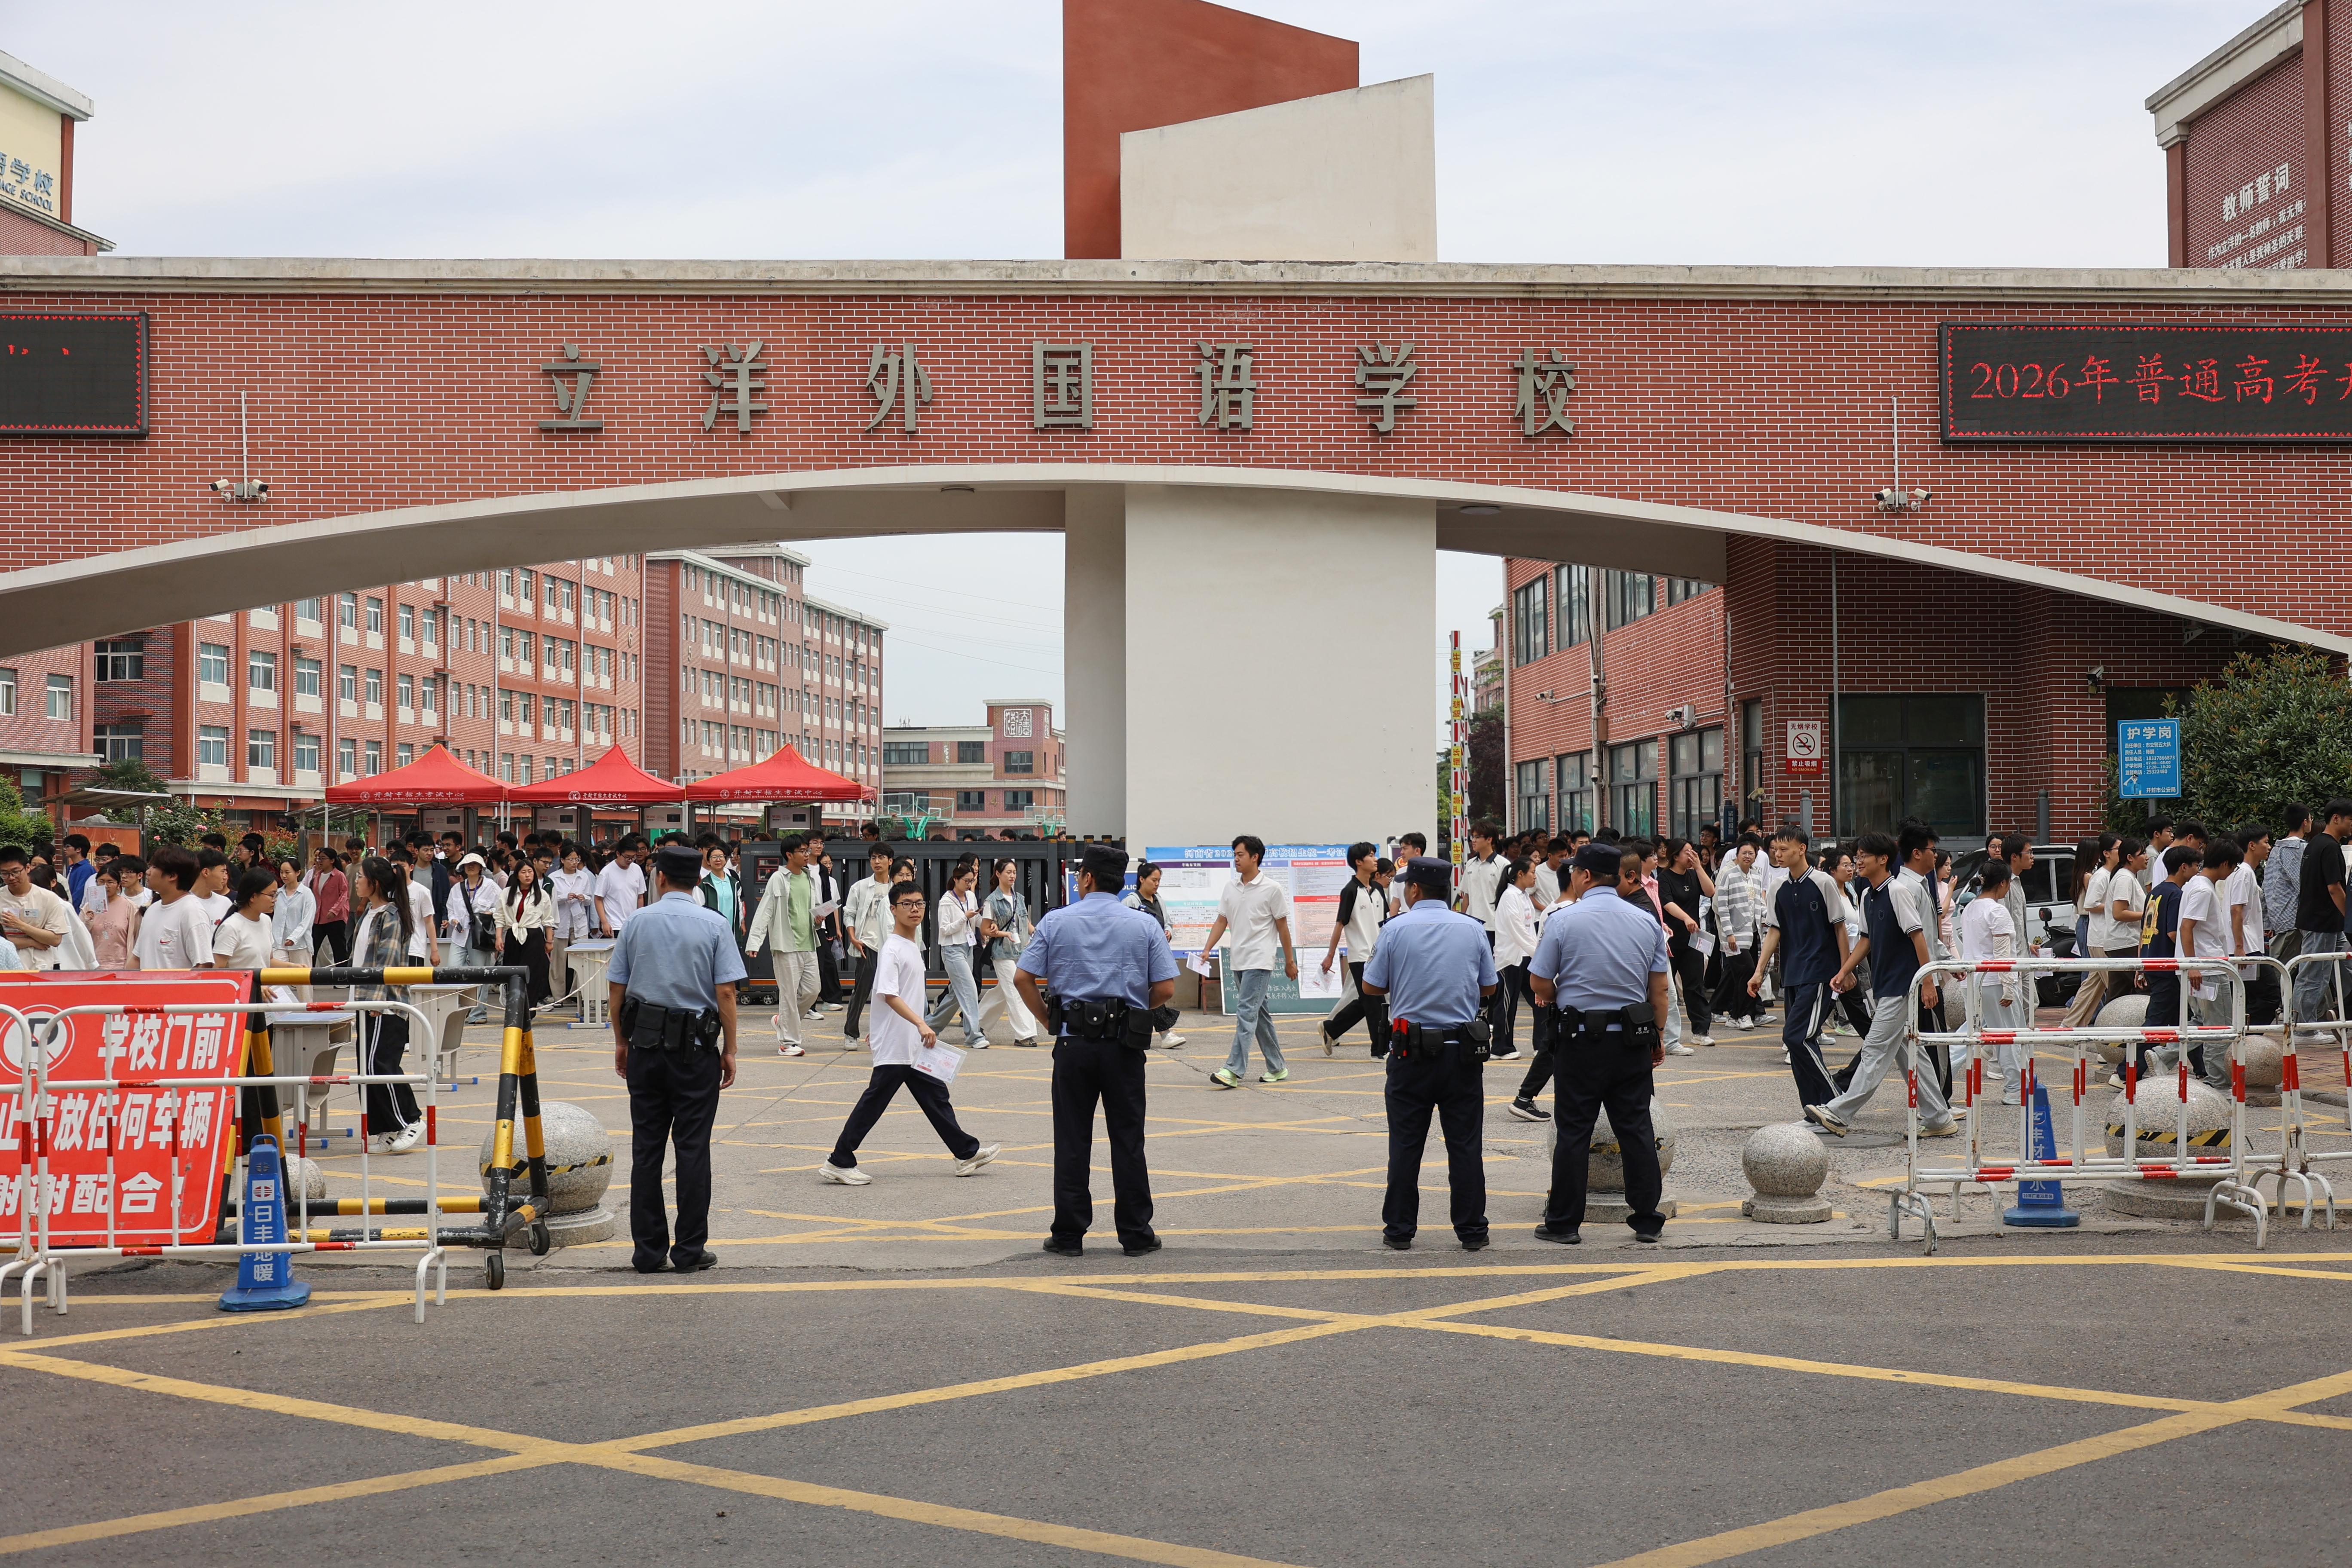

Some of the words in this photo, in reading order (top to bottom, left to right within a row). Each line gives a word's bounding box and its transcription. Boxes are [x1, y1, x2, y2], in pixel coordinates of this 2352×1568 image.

[0, 178, 16, 196] AGE
[20, 189, 53, 211] SCHOOL
[2223, 162, 2289, 222] 教师誓词
[2265, 249, 2307, 269] 可爱的学
[538, 341, 1575, 436] 立洋外国语学校
[1970, 353, 2352, 405] 2026年普通高考
[2127, 726, 2171, 740] 护学岗
[990, 795, 998, 807] 4
[97, 1012, 225, 1071] 学校门前
[253, 1205, 273, 1282] 日丰地暖
